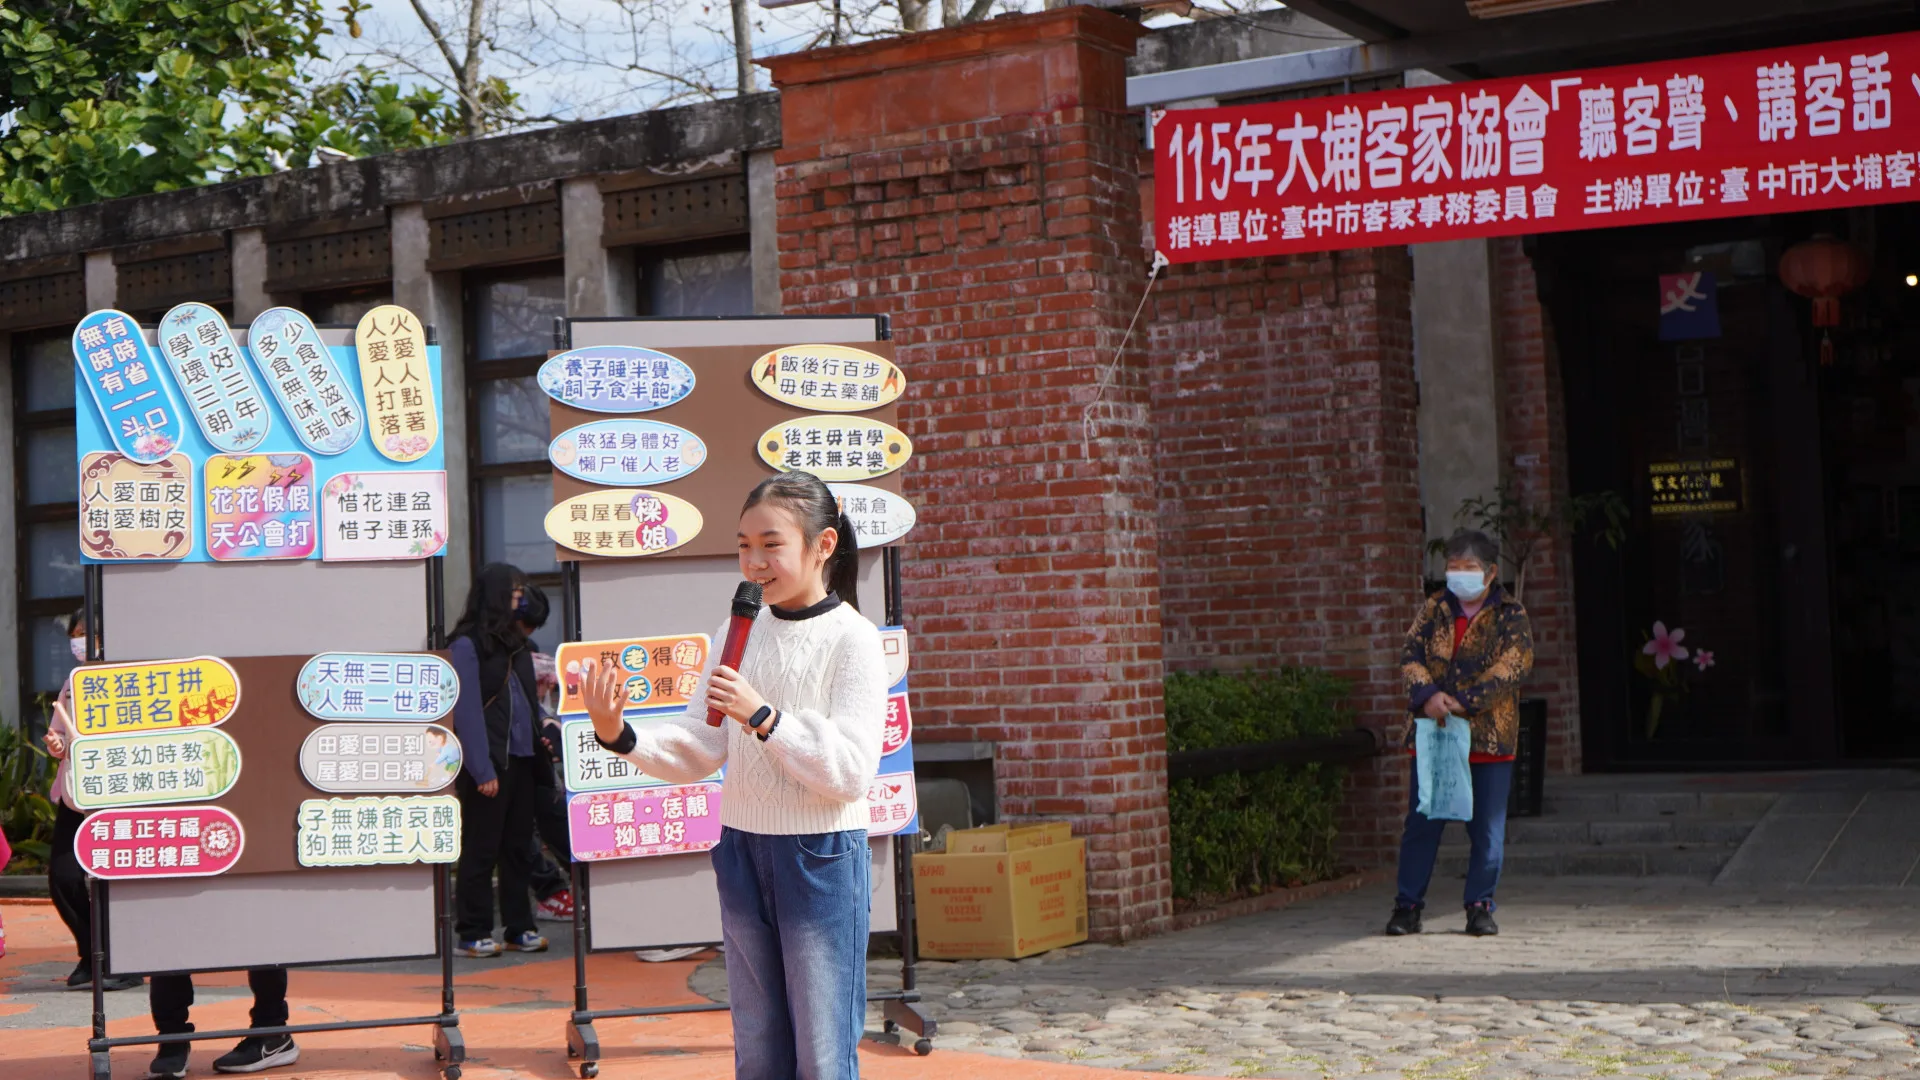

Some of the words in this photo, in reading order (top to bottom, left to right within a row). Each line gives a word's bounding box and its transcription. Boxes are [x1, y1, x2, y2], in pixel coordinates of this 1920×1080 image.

[1584, 150, 1920, 215] 主辦單位:臺中市大埔客
[103, 316, 168, 430] 有時省一口
[195, 321, 260, 419] 學好三年
[284, 322, 355, 428] 少食多滋味
[366, 317, 400, 436] 人愛人打落
[390, 314, 426, 432] 火愛人點著
[565, 359, 669, 379] 養子睡半覺
[781, 355, 880, 378] 飯後行百步
[79, 325, 145, 438] 無時有一斗
[168, 333, 233, 433] 學壞三朝
[565, 380, 669, 399] 飼子食半飽
[578, 432, 680, 450] 煞猛身體好
[785, 428, 883, 447] 後生毋肯學
[578, 455, 680, 473] 懶尸催人老
[785, 450, 883, 467] 老來無安樂
[87, 481, 186, 503] 人愛面皮
[210, 486, 310, 514] 花花假假
[338, 491, 432, 512] 惜花連盆
[570, 497, 662, 523] 買屋看樑
[842, 497, 887, 513] 滿倉
[87, 508, 186, 530] 樹愛樹皮
[339, 519, 433, 540] 惜子連孫
[853, 520, 887, 535] 米缸
[211, 520, 310, 549] 天公會打
[573, 524, 668, 550] 娶妻看娘
[600, 643, 699, 670] 敬老得福
[82, 667, 203, 700] 煞猛打拼
[318, 662, 440, 686] 天無三日雨
[84, 698, 173, 729] 打頭名
[317, 689, 439, 713] 人無一世窮
[80, 741, 203, 770] 子愛幼時教
[318, 735, 424, 756] 田愛日日到
[317, 760, 424, 781] 屋愛日日掃
[580, 756, 644, 780] 洗面
[82, 768, 204, 795] 筍愛嫩時拗
[90, 817, 200, 841] 有量正有福
[306, 805, 454, 831] 子無嫌爺哀醜
[306, 830, 454, 856] 狗無怨主人窮
[615, 821, 685, 848] 拗蠻好
[91, 845, 200, 870] 買田起樓屋
